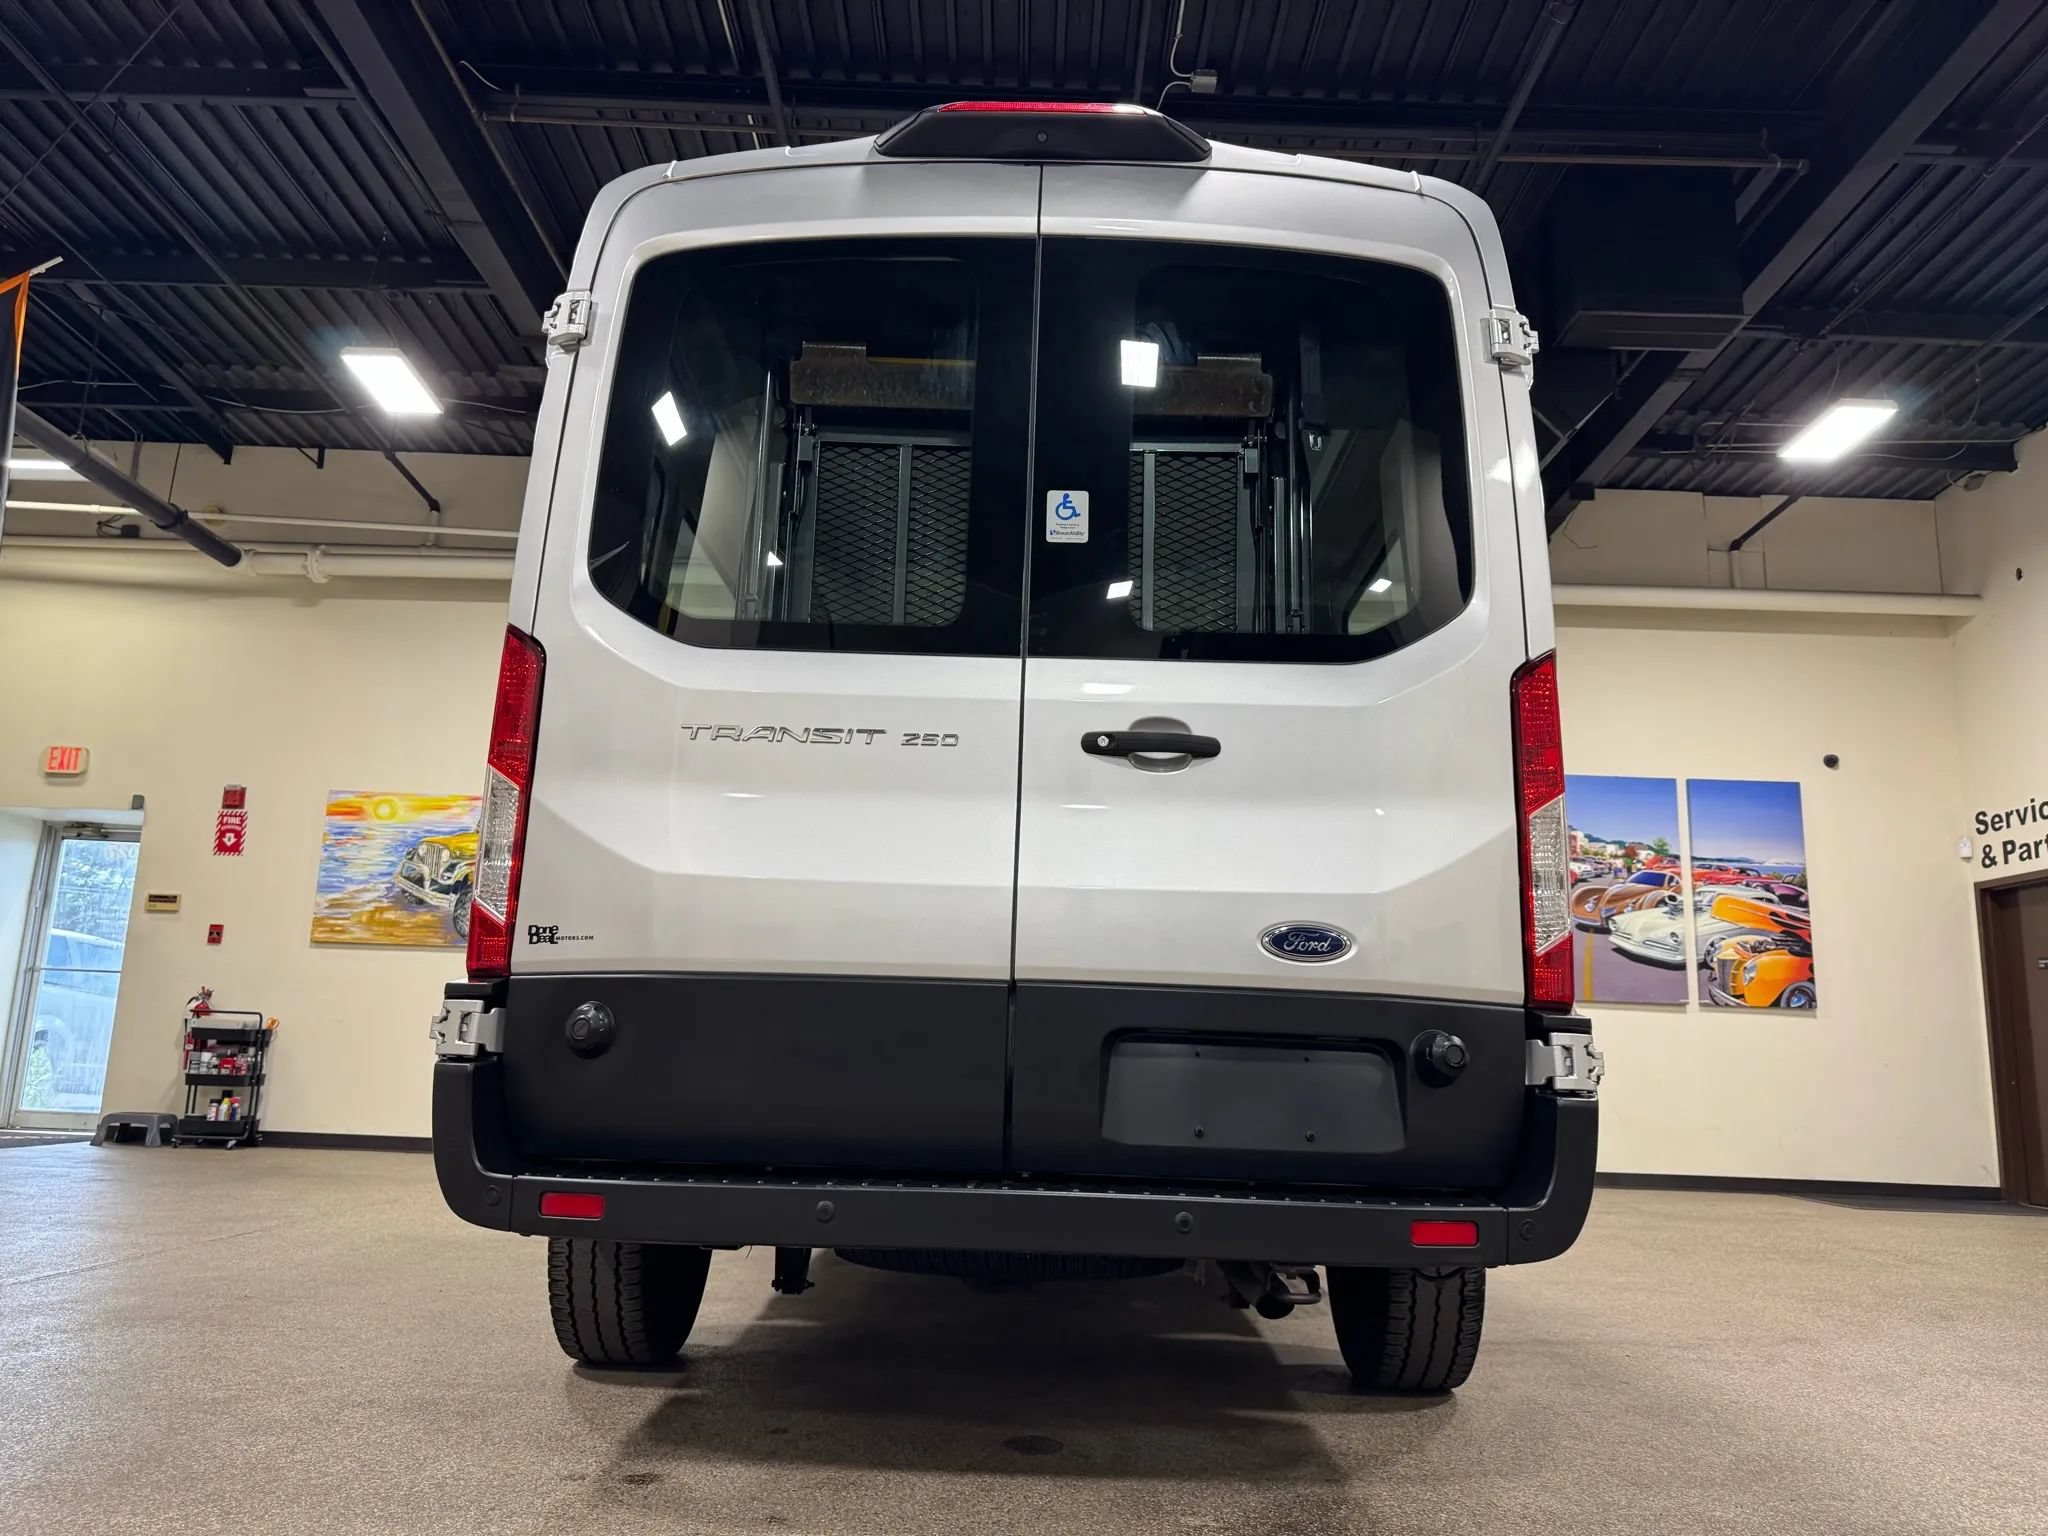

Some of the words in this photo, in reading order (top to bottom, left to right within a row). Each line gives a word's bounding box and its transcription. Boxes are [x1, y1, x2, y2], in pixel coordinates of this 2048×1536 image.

[681, 724, 887, 745] TRANSIT
[901, 733, 959, 747] 250
[48, 746, 82, 771] EXIT
[222, 816, 242, 824] FIRE
[1981, 844, 1998, 869] &
[528, 924, 559, 935] Done
[1283, 931, 1331, 952] Ford
